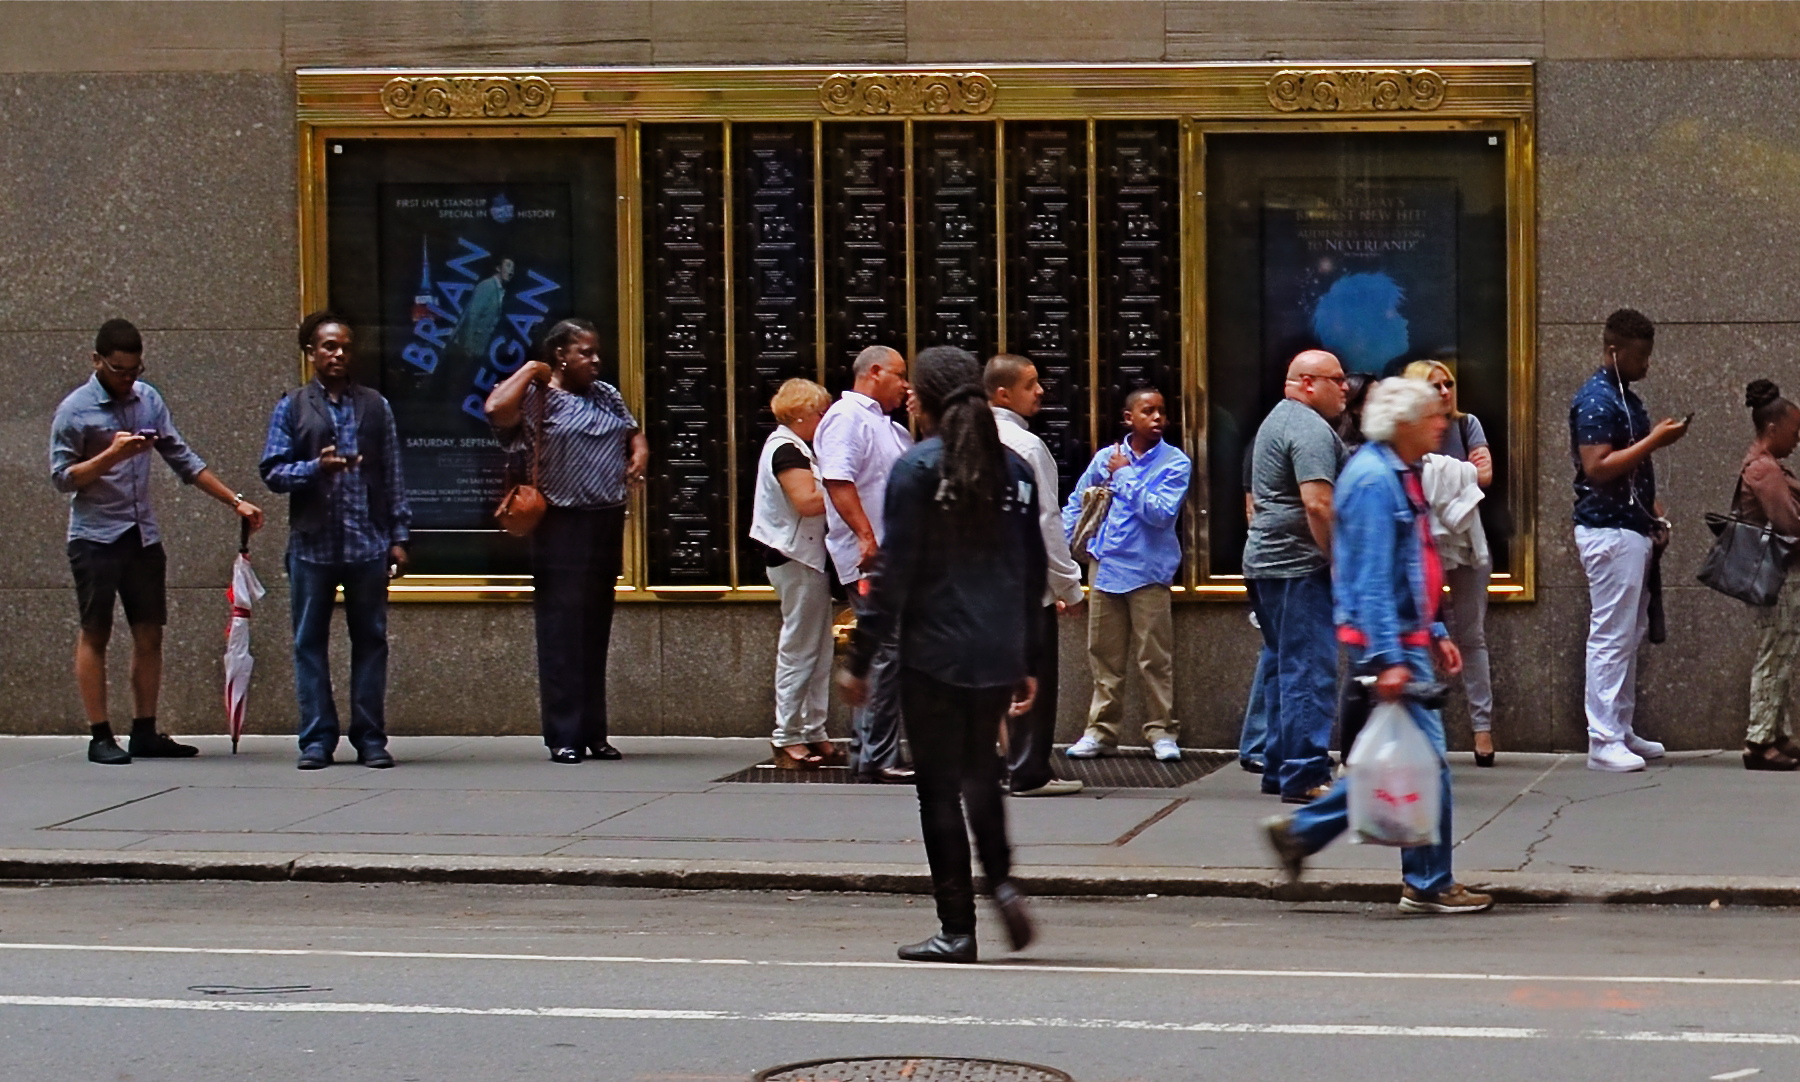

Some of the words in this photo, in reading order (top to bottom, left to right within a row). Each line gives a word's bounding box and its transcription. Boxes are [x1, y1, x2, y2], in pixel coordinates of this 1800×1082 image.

[396, 199, 419, 208] FIRST
[421, 199, 440, 208] LIVE
[443, 199, 487, 208] STAND-UP
[439, 209, 474, 218] SPECIAL
[476, 209, 487, 218] IN
[518, 209, 556, 218] HISTORY
[401, 237, 492, 374] BRIAN
[406, 437, 456, 449] SATURDAY,
[460, 437, 500, 448] SEPTEM
